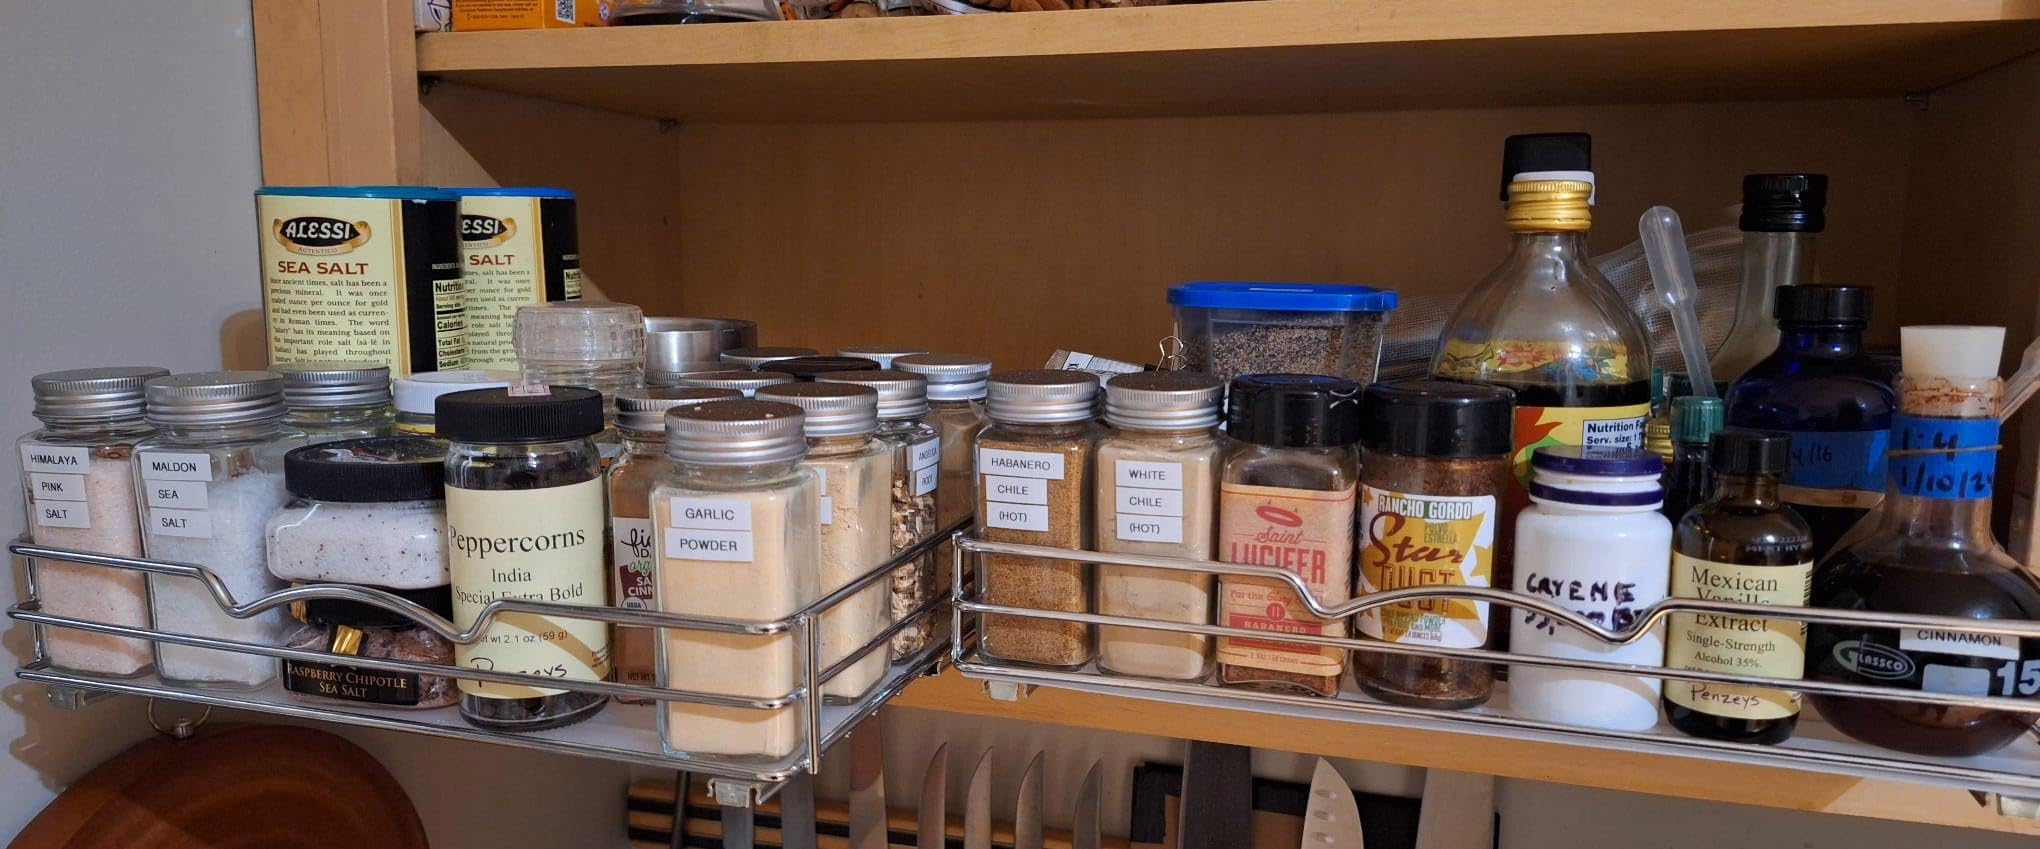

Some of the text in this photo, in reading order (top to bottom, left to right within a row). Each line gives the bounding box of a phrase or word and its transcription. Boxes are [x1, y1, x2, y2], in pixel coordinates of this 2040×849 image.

[286, 222, 351, 239] ALESSI
[469, 254, 515, 265] SALT
[278, 261, 368, 275] SEA SALT
[346, 279, 359, 287] has
[361, 279, 381, 287] been
[371, 299, 388, 308] gold
[308, 308, 326, 316] been
[470, 314, 502, 322] meaning
[317, 329, 351, 337] meaning
[1587, 422, 1634, 433] Nutrition
[1587, 436, 1612, 445] Serv.
[1614, 434, 1632, 444] size:
[31, 454, 78, 465] HIMALAYA
[991, 457, 1051, 471] HABANERO
[152, 461, 197, 472] MALDON
[1128, 469, 1165, 481] WHITE
[41, 481, 64, 492] PINK
[997, 484, 1029, 496] CHILE
[158, 489, 179, 499] SEA
[1128, 496, 1162, 508] CHILE
[1378, 494, 1472, 520] RANCHO GORDO
[46, 509, 69, 520] SALT
[685, 508, 735, 521] GARLIC
[998, 511, 1027, 523] (HOT)
[161, 517, 188, 529] SALT
[1129, 523, 1160, 535] (HOT)
[450, 524, 585, 559] Peppercorns
[1256, 528, 1304, 545] Saint
[1370, 512, 1463, 567] Star
[680, 538, 738, 552] POWDER
[1231, 542, 1326, 585] LUCIFER
[492, 567, 532, 583] India
[1691, 566, 1778, 592] Mexican
[455, 585, 494, 605] Special
[550, 582, 583, 602] Bold
[1695, 614, 1768, 632] Extract
[523, 635, 535, 643] oz
[558, 630, 568, 641] g)
[1686, 630, 1775, 653] Single-Strength
[1917, 630, 2001, 645] CINNAMON
[1694, 651, 1733, 666] Alcohol
[287, 663, 407, 689] RASPBERRY CHIPOTLE
[319, 682, 368, 698] SEA SALT
[1690, 684, 1761, 711] Penzeys
